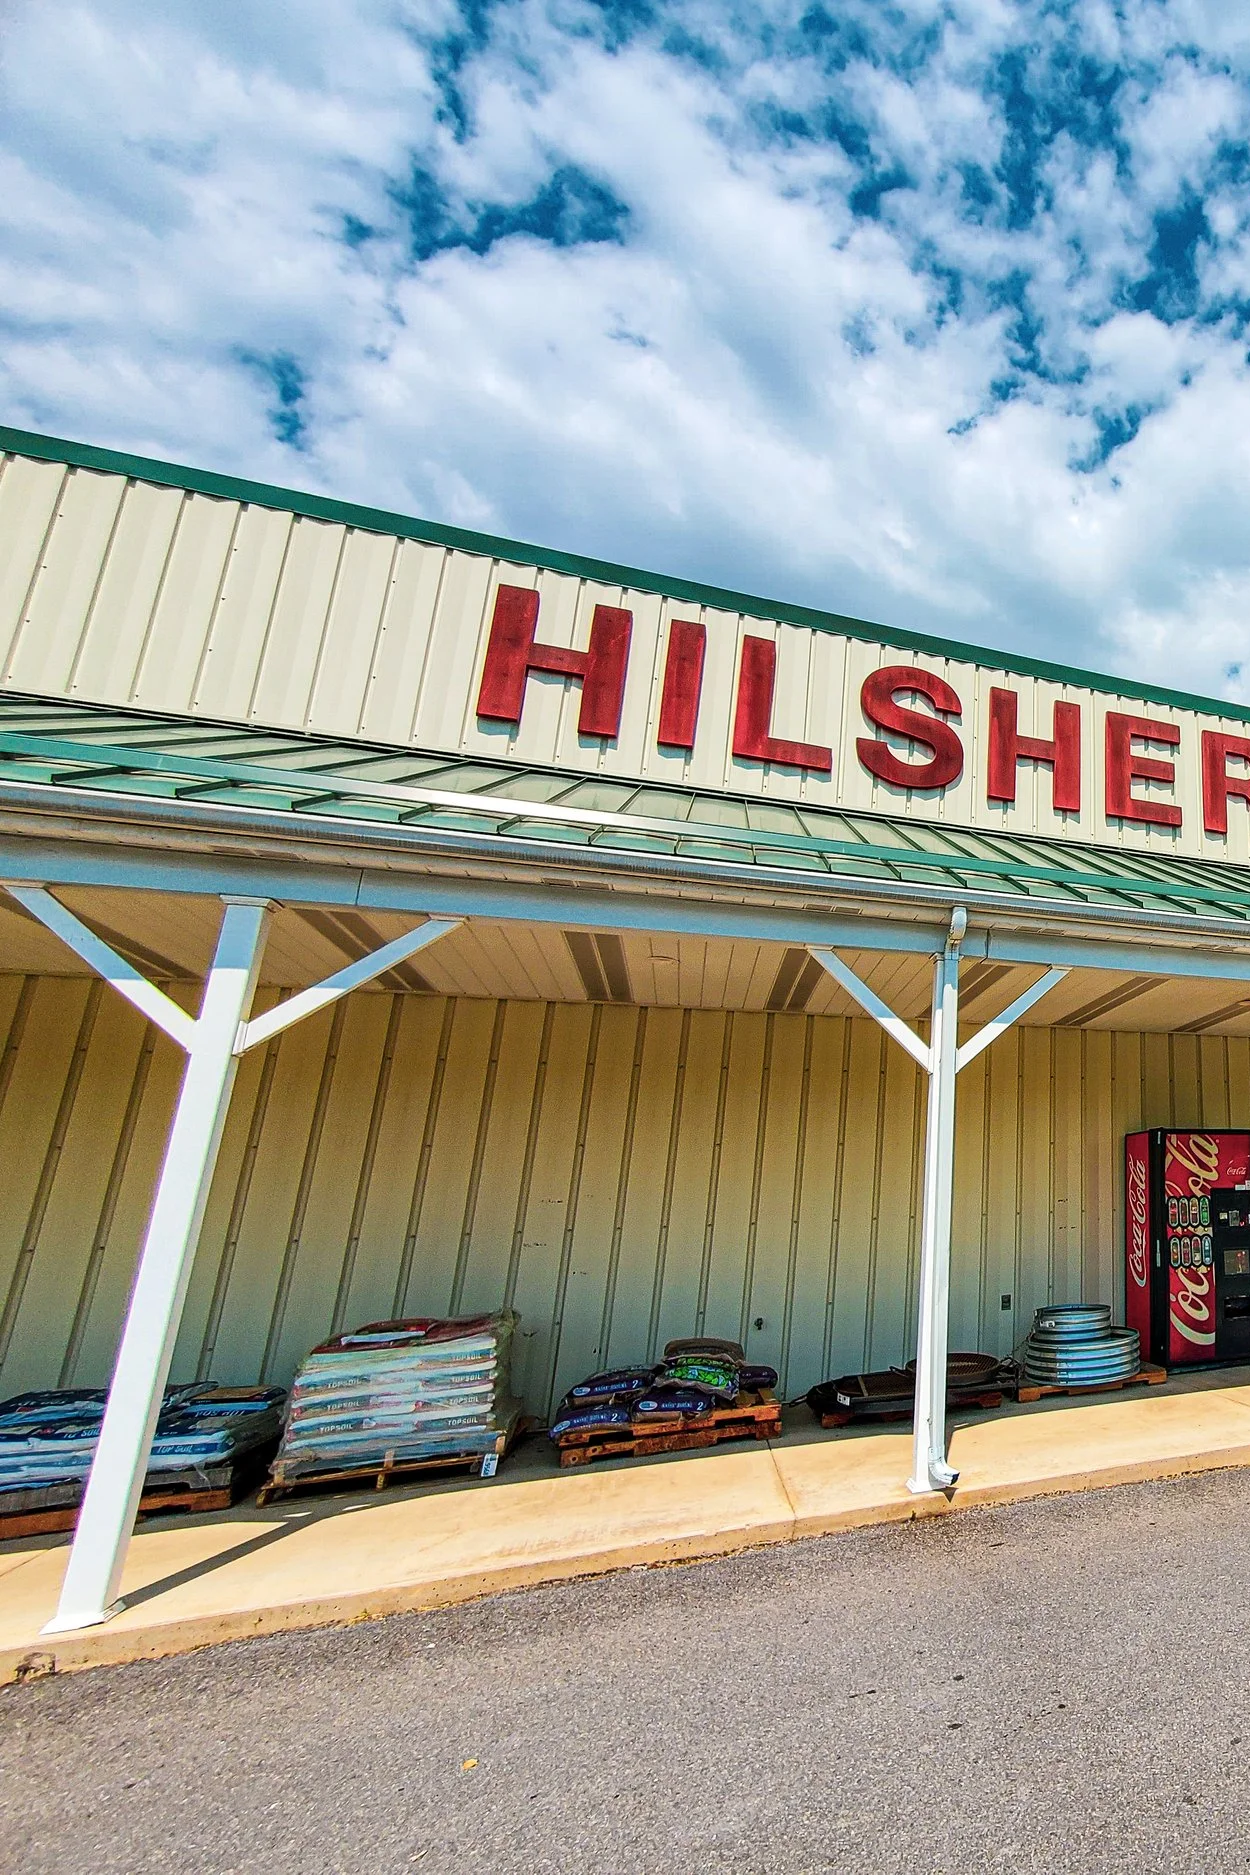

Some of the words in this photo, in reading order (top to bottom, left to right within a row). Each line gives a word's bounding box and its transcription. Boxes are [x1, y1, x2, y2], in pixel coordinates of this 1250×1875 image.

[327, 1400, 361, 1411] TOPSOIL
[697, 1402, 704, 1411] 2
[447, 1416, 479, 1426] TOPSOIL
[611, 1413, 618, 1422] 2
[320, 1423, 354, 1434] TOPSOIL
